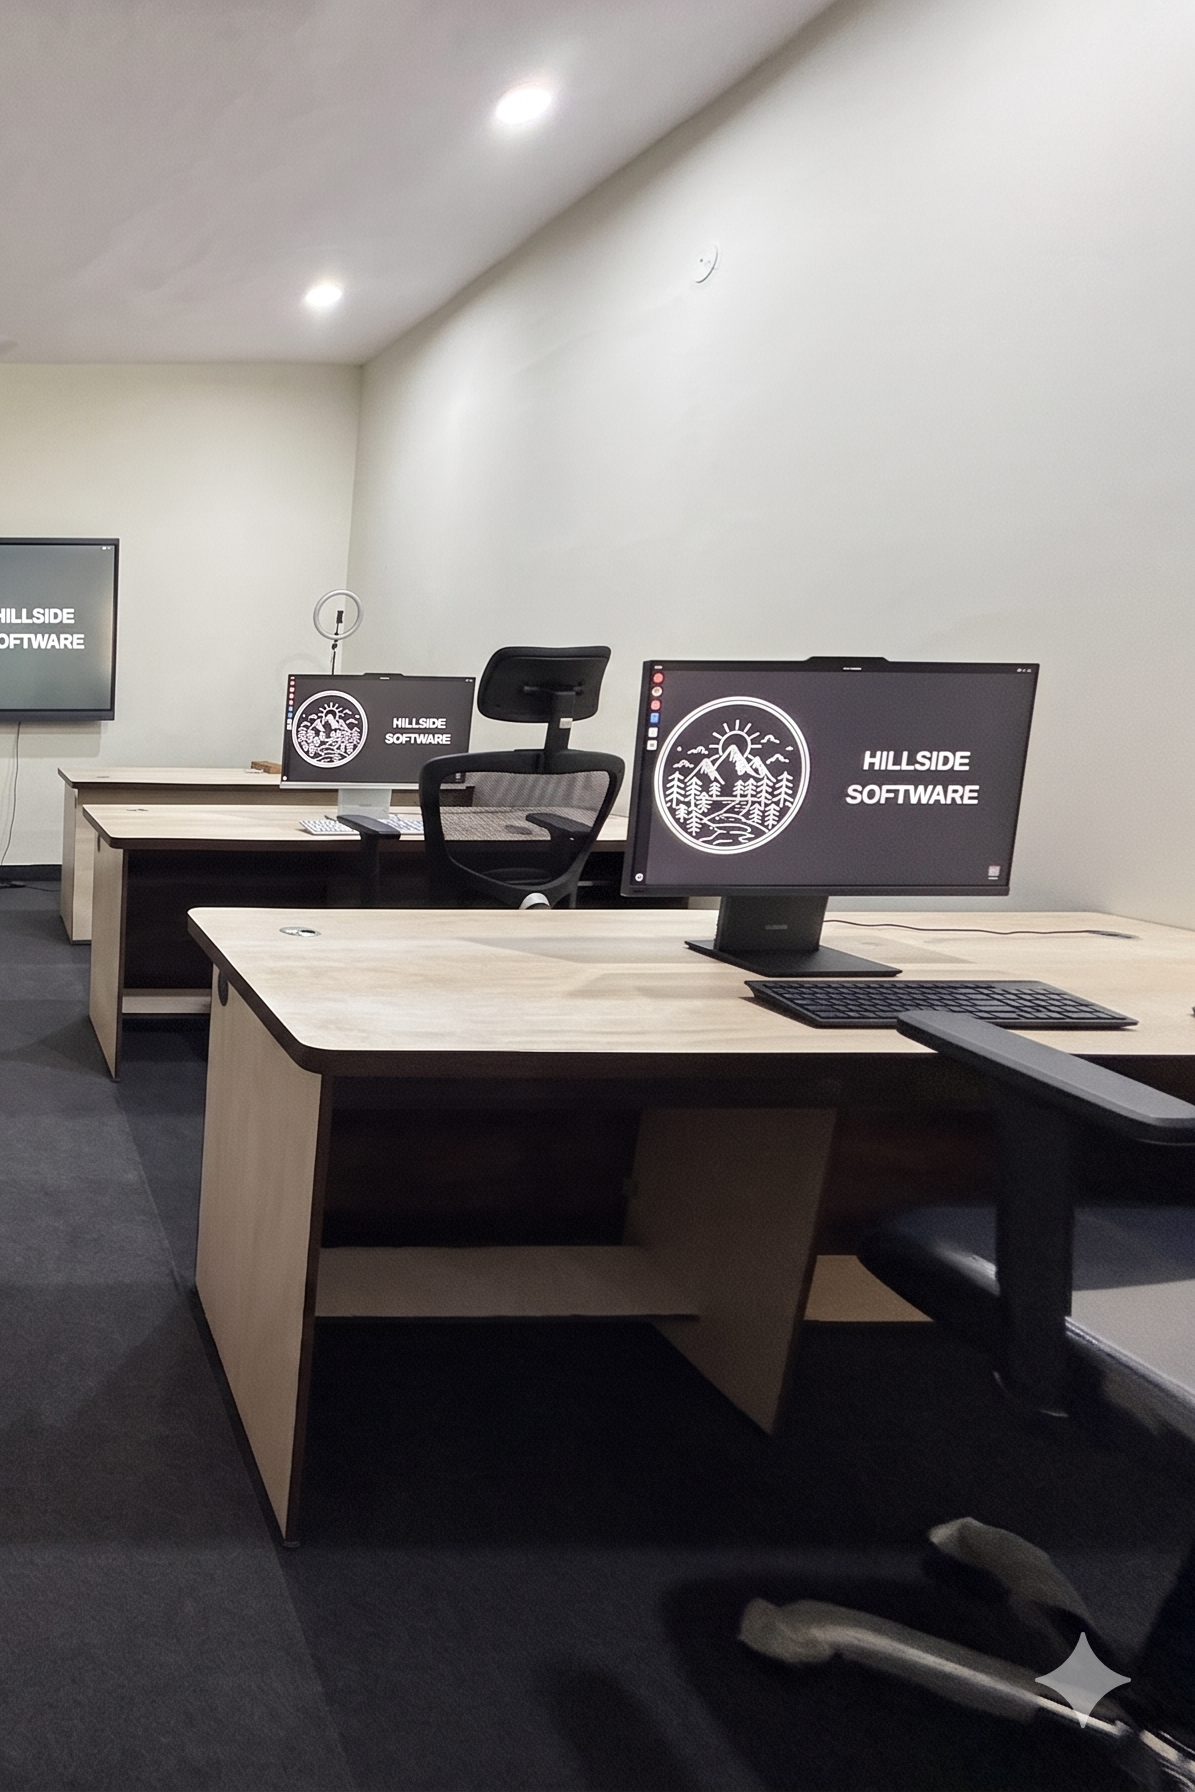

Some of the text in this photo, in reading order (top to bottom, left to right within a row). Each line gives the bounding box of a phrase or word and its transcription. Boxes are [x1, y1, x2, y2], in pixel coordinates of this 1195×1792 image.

[392, 717, 446, 729] HILLSIDE
[384, 733, 451, 745] SOFTWARE
[862, 750, 971, 771] HILLSIDE
[845, 784, 979, 805] SOFTWARE
